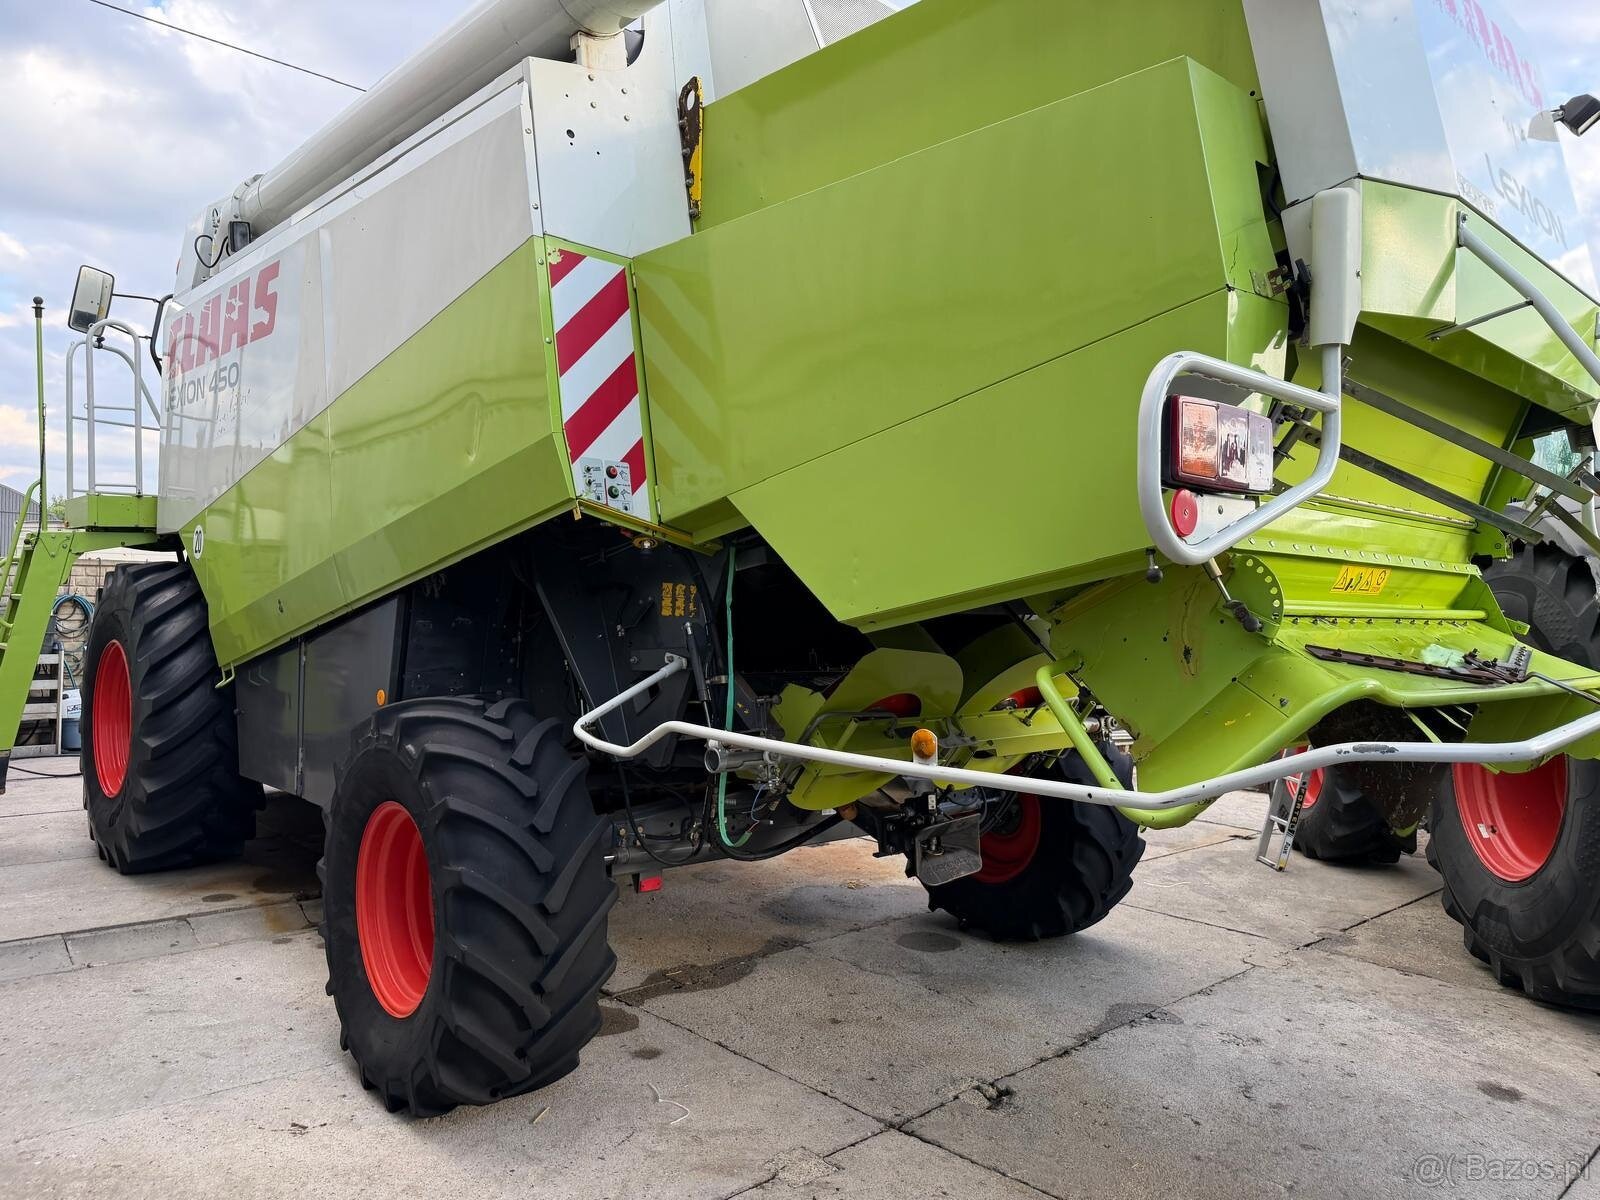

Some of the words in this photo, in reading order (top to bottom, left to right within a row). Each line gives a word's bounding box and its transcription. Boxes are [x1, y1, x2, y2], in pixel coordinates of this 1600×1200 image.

[1484, 152, 1568, 250] LEXION
[209, 362, 240, 394] 450
[195, 530, 202, 554] 20
